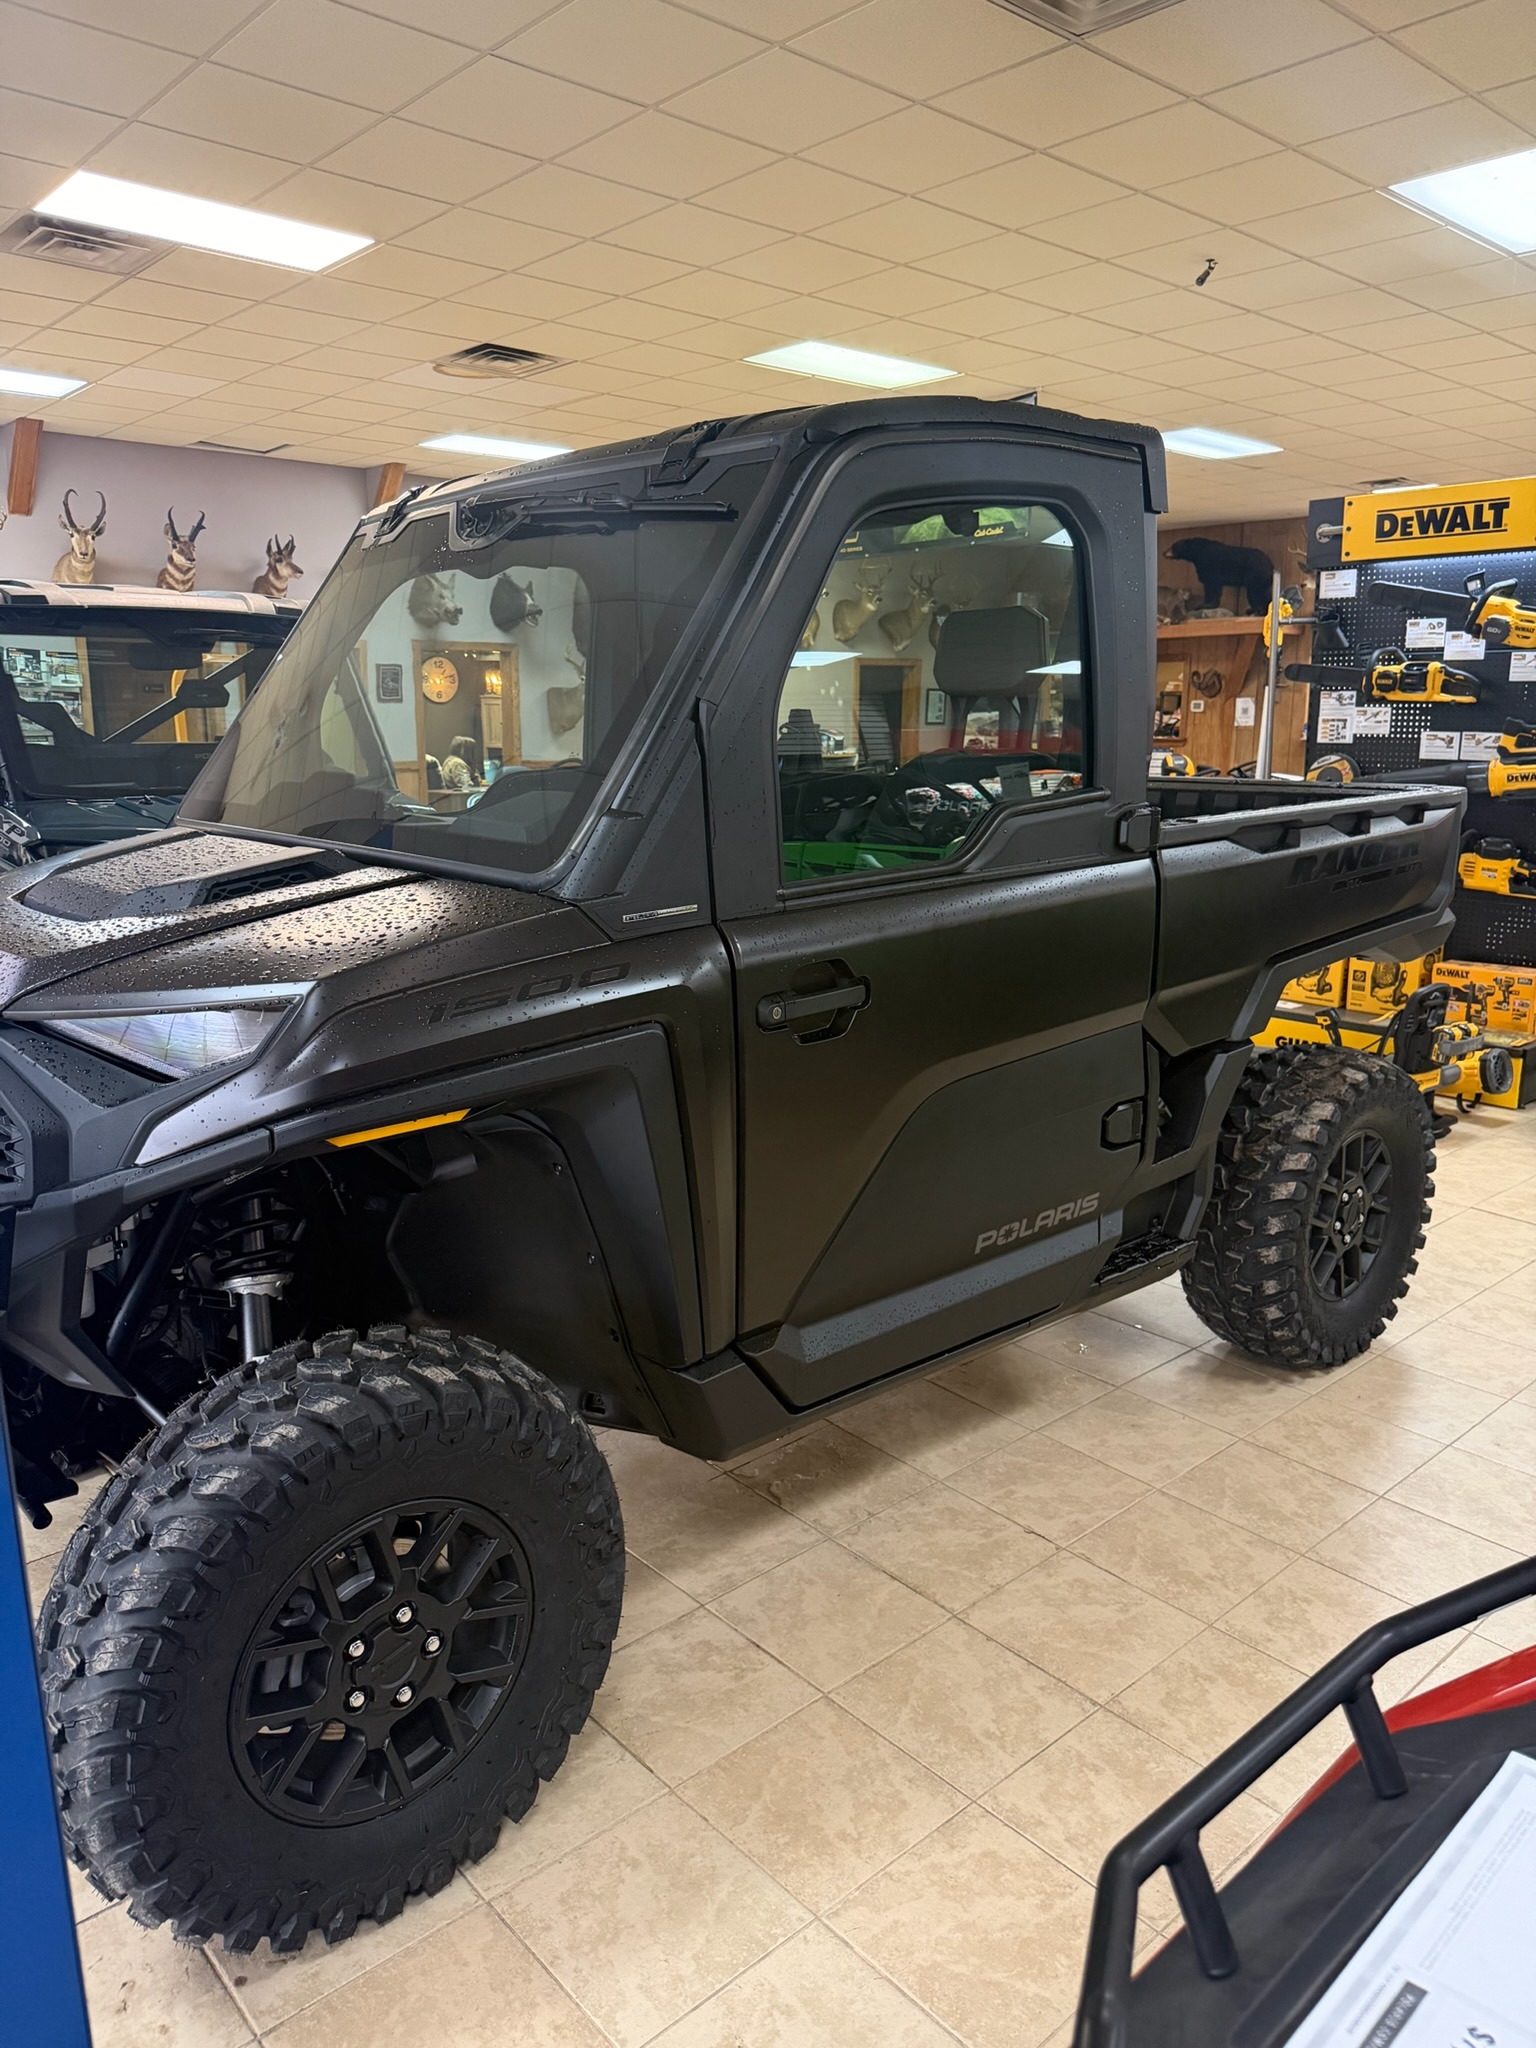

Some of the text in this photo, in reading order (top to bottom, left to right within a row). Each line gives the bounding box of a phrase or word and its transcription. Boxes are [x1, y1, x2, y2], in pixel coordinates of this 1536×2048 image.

[1375, 501, 1510, 539] DEWALT
[433, 660, 444, 669] 12
[436, 690, 443, 699] 6
[1436, 967, 1470, 979] DEWALT
[425, 961, 632, 1025] 1500
[974, 1192, 1100, 1255] POLARIS
